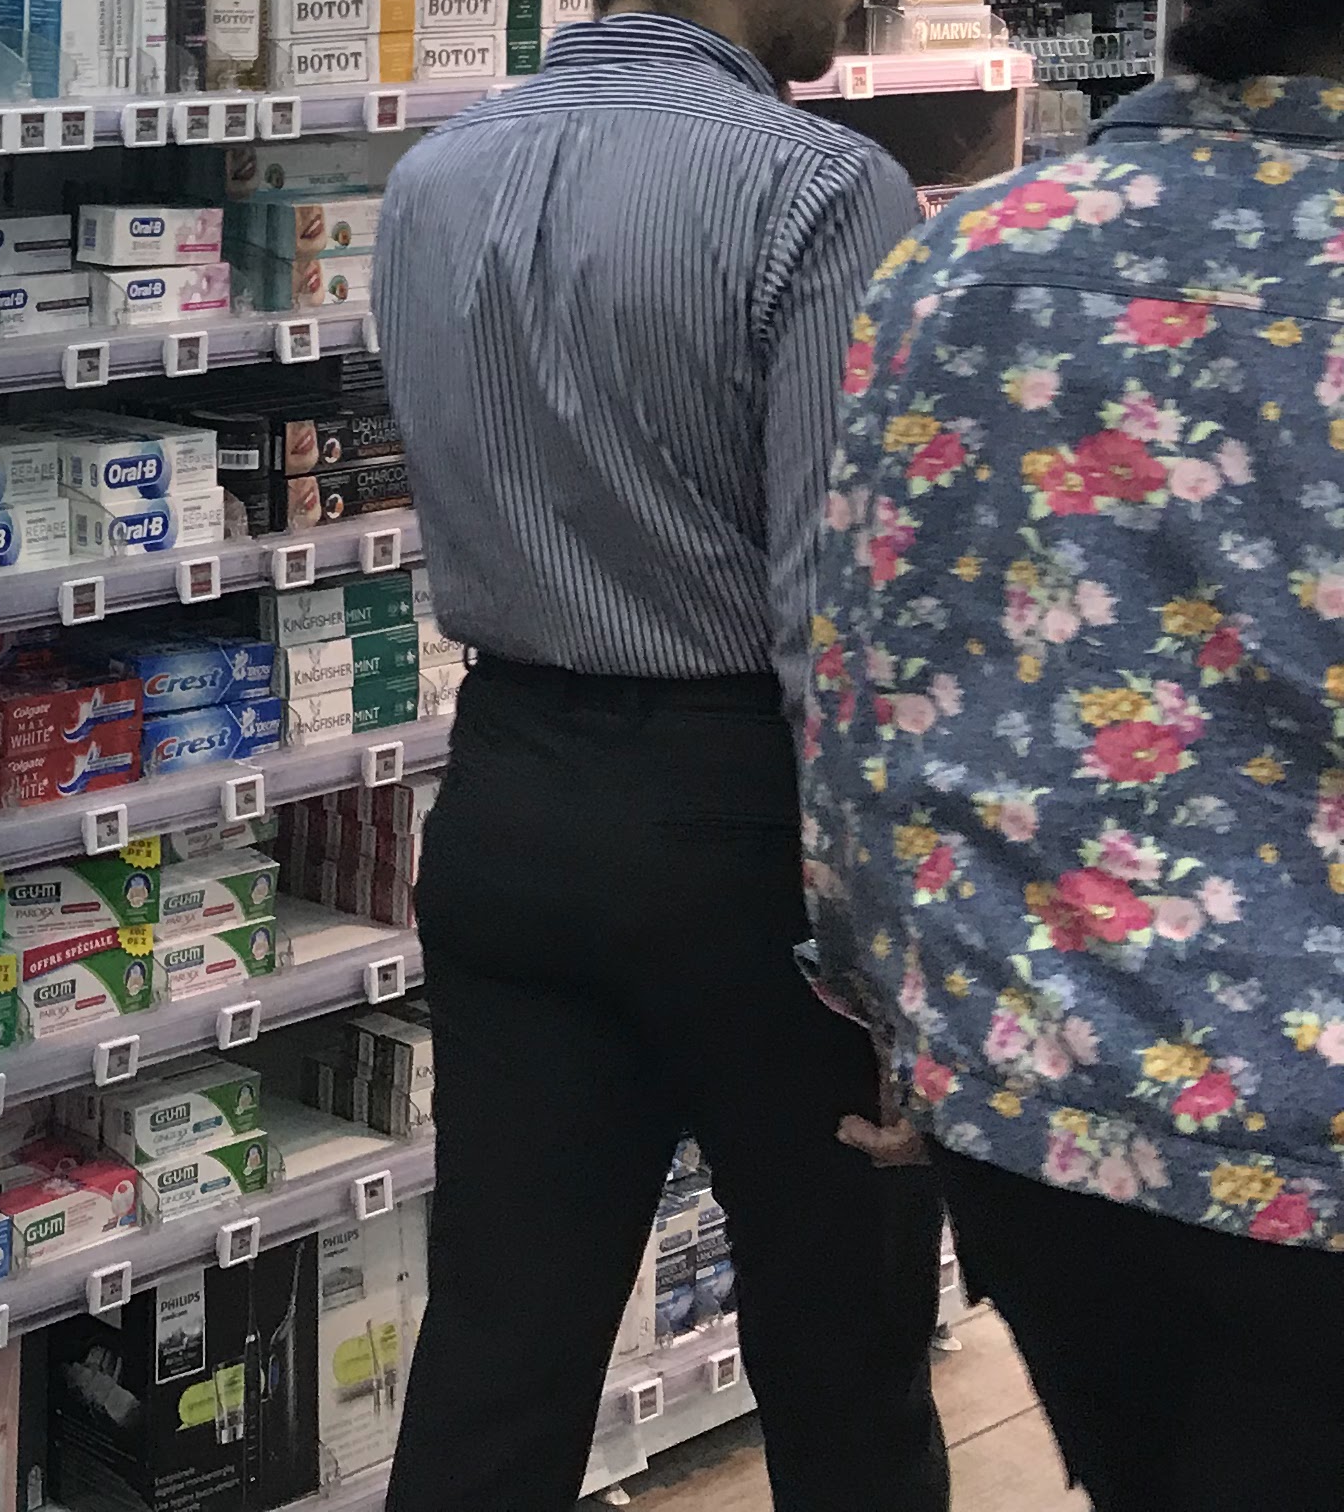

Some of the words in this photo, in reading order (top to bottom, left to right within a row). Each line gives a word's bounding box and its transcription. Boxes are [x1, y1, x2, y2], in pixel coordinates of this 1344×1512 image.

[213, 14, 256, 25] BOTOT
[296, 0, 363, 21] BOTOT
[930, 22, 981, 41] MARVIS
[297, 52, 363, 72] BOTOT
[425, 48, 489, 67] BOTOT
[132, 220, 163, 235] Oral-B
[129, 282, 163, 298] Oral-B
[108, 458, 157, 483] Oral-B
[113, 517, 163, 542] Oral-B
[283, 611, 344, 633] KINGFISHER
[346, 607, 372, 623] MINT
[294, 663, 352, 686] KINGFISHER
[354, 657, 381, 674] MINT
[144, 668, 223, 700] Crest
[13, 703, 51, 720] Colgate
[294, 713, 352, 735] KINGFISHER
[353, 707, 380, 722] MINT
[18, 719, 44, 732] MAX
[10, 730, 51, 749] WHITE
[155, 727, 232, 761] Crest
[30, 953, 62, 973] OFFRE
[65, 935, 112, 959] SPÉCIALE
[322, 1229, 360, 1249] PHILIPS
[160, 1291, 201, 1313] PHILIPS
